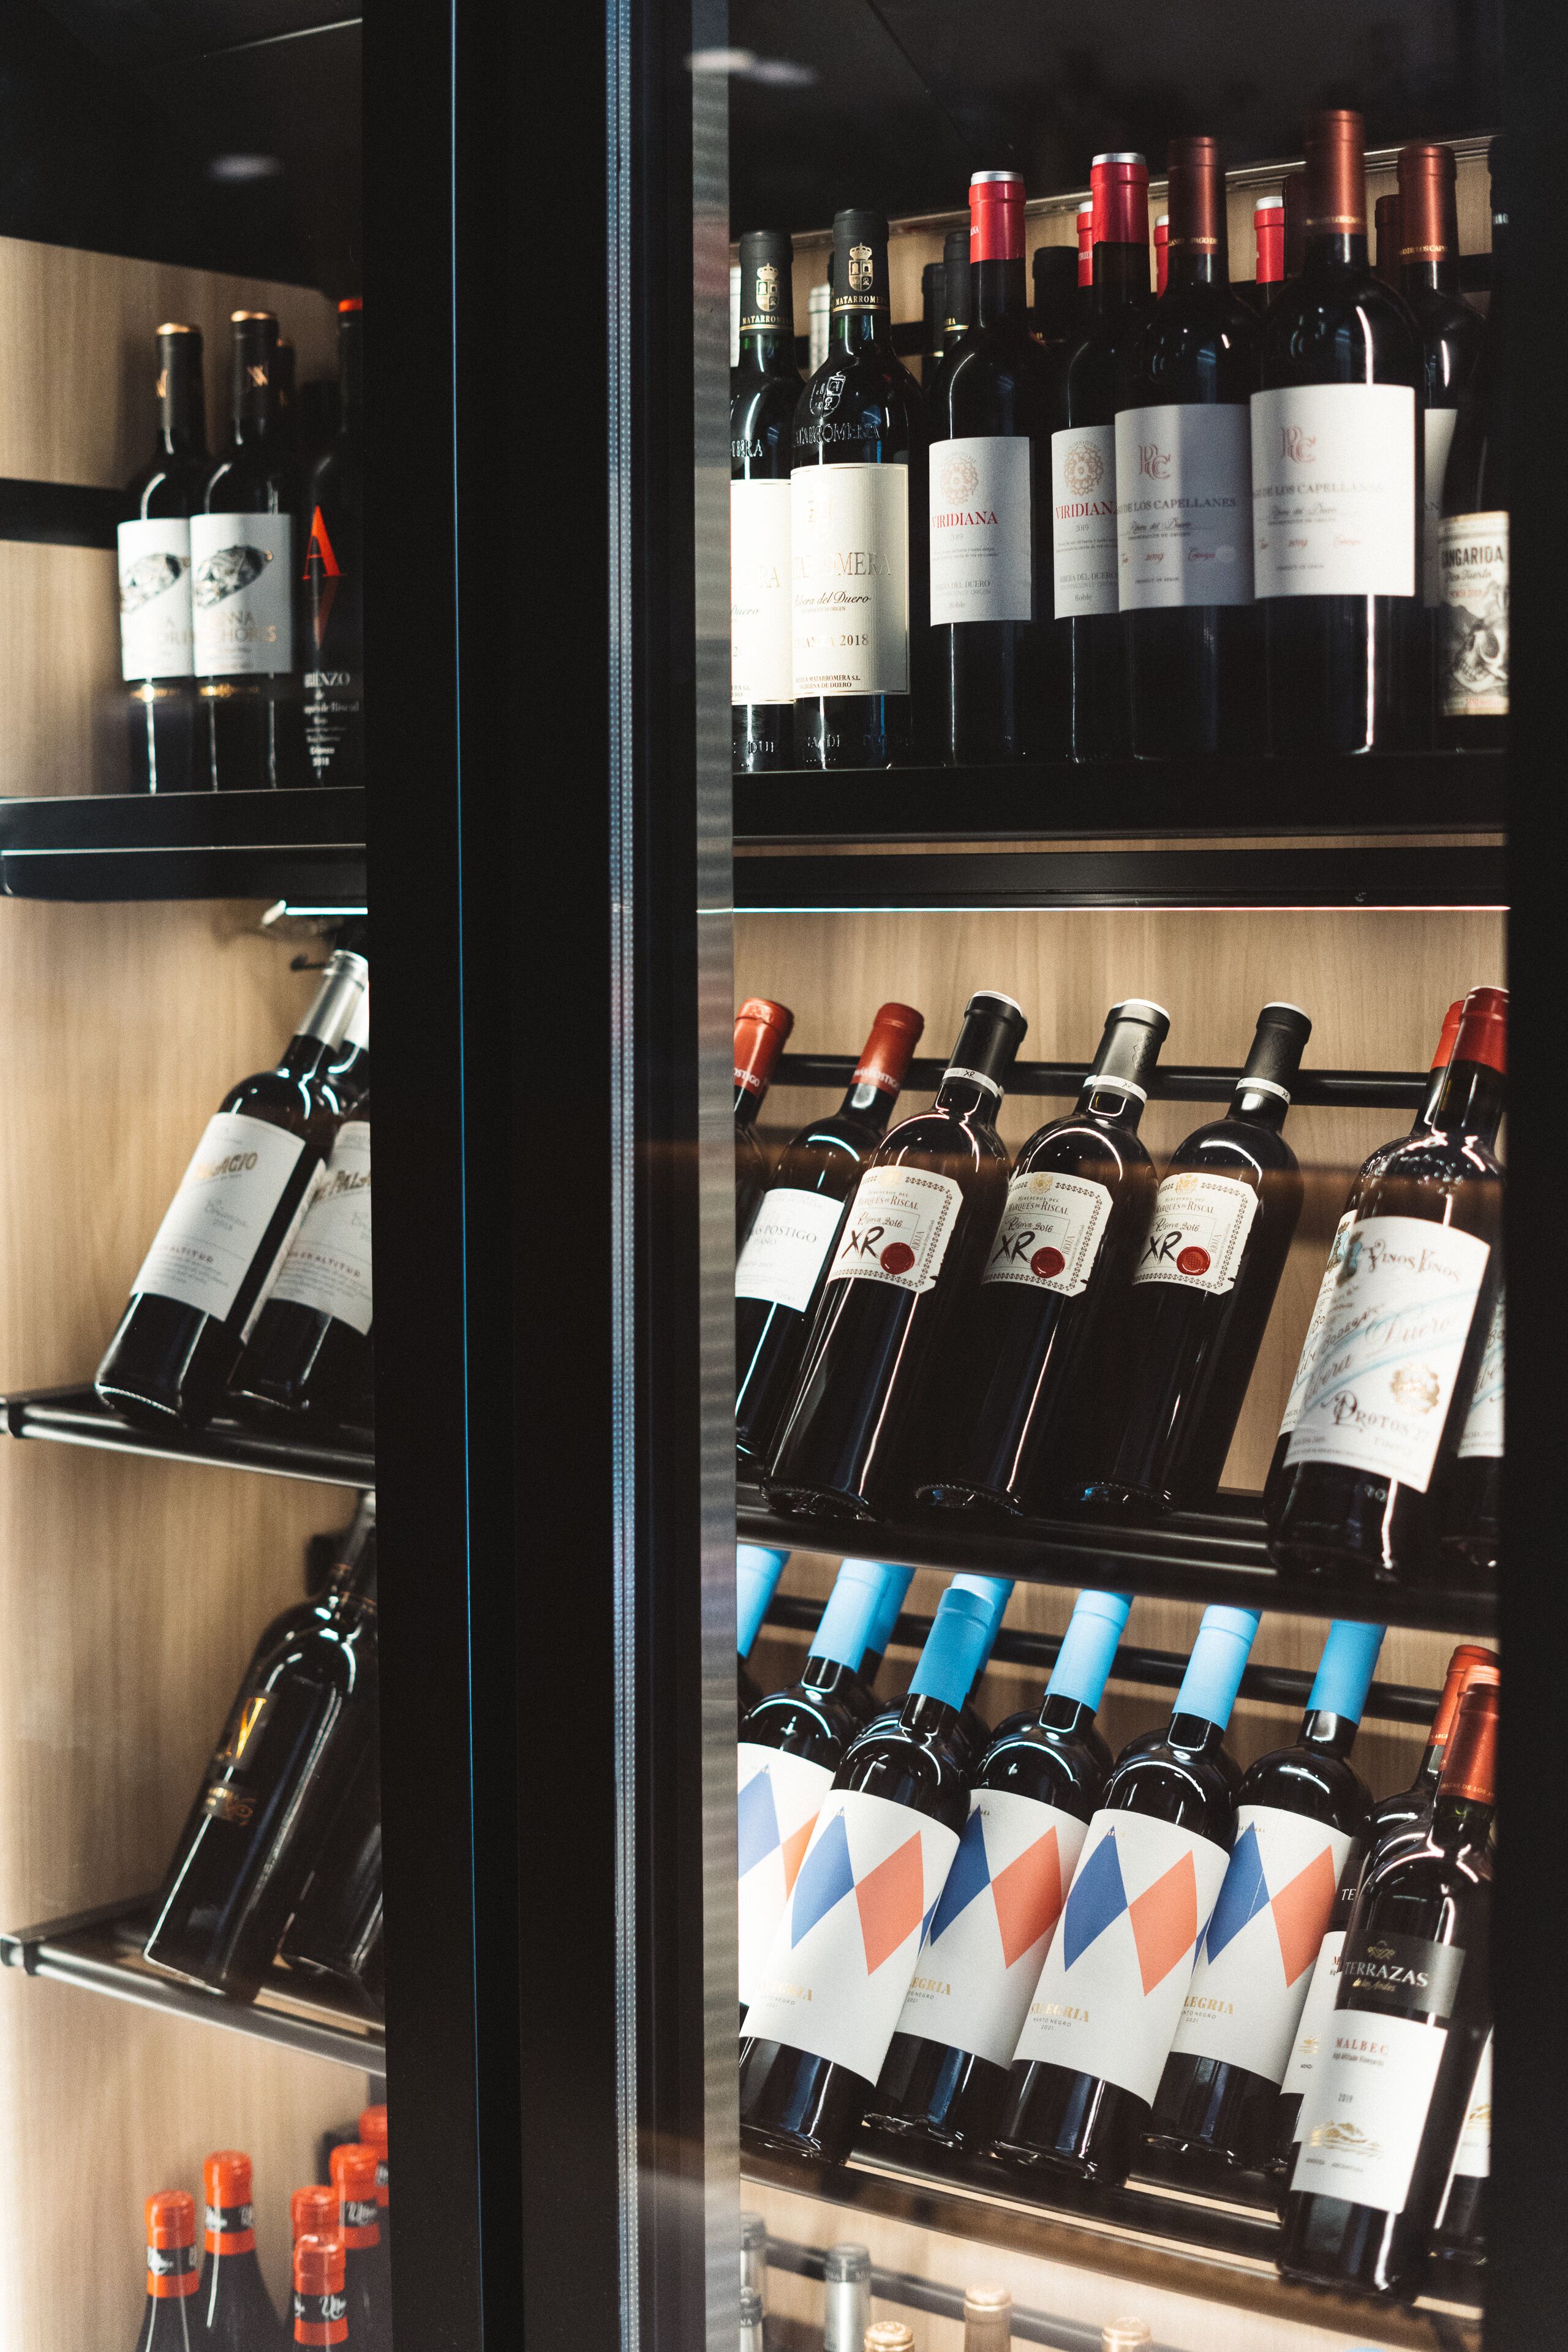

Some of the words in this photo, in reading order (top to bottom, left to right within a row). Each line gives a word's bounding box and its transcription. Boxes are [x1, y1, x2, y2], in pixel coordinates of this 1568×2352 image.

[1134, 500, 1152, 511] LOS
[1153, 498, 1236, 510] CAPELLANES
[932, 511, 999, 529] VIRIDIANA
[817, 591, 834, 605] del
[834, 590, 872, 604] Duero
[839, 634, 869, 646] 2018
[963, 1070, 975, 1079] XR
[881, 1216, 903, 1228] 2016
[1032, 1221, 1054, 1233] 2016
[1180, 1222, 1200, 1232] 2016
[764, 1224, 817, 1243] POSTIGO
[841, 1226, 885, 1261] XR
[992, 1231, 1036, 1265] XR
[1061, 1234, 1076, 1256] RIOJA
[1140, 1231, 1183, 1267] XR
[1321, 1389, 1409, 1435] PROTOS
[1341, 1888, 1357, 1901] TE
[1344, 1961, 1429, 1988] TERRAZAS
[910, 1976, 951, 1996] EGRIA
[775, 1997, 796, 2005] NEGRO
[914, 1991, 935, 2000] NEGRO
[1183, 1995, 1234, 2015] LEGRIA
[1050, 2019, 1072, 2027] NEGRO
[1335, 2037, 1389, 2056] MALBEC
